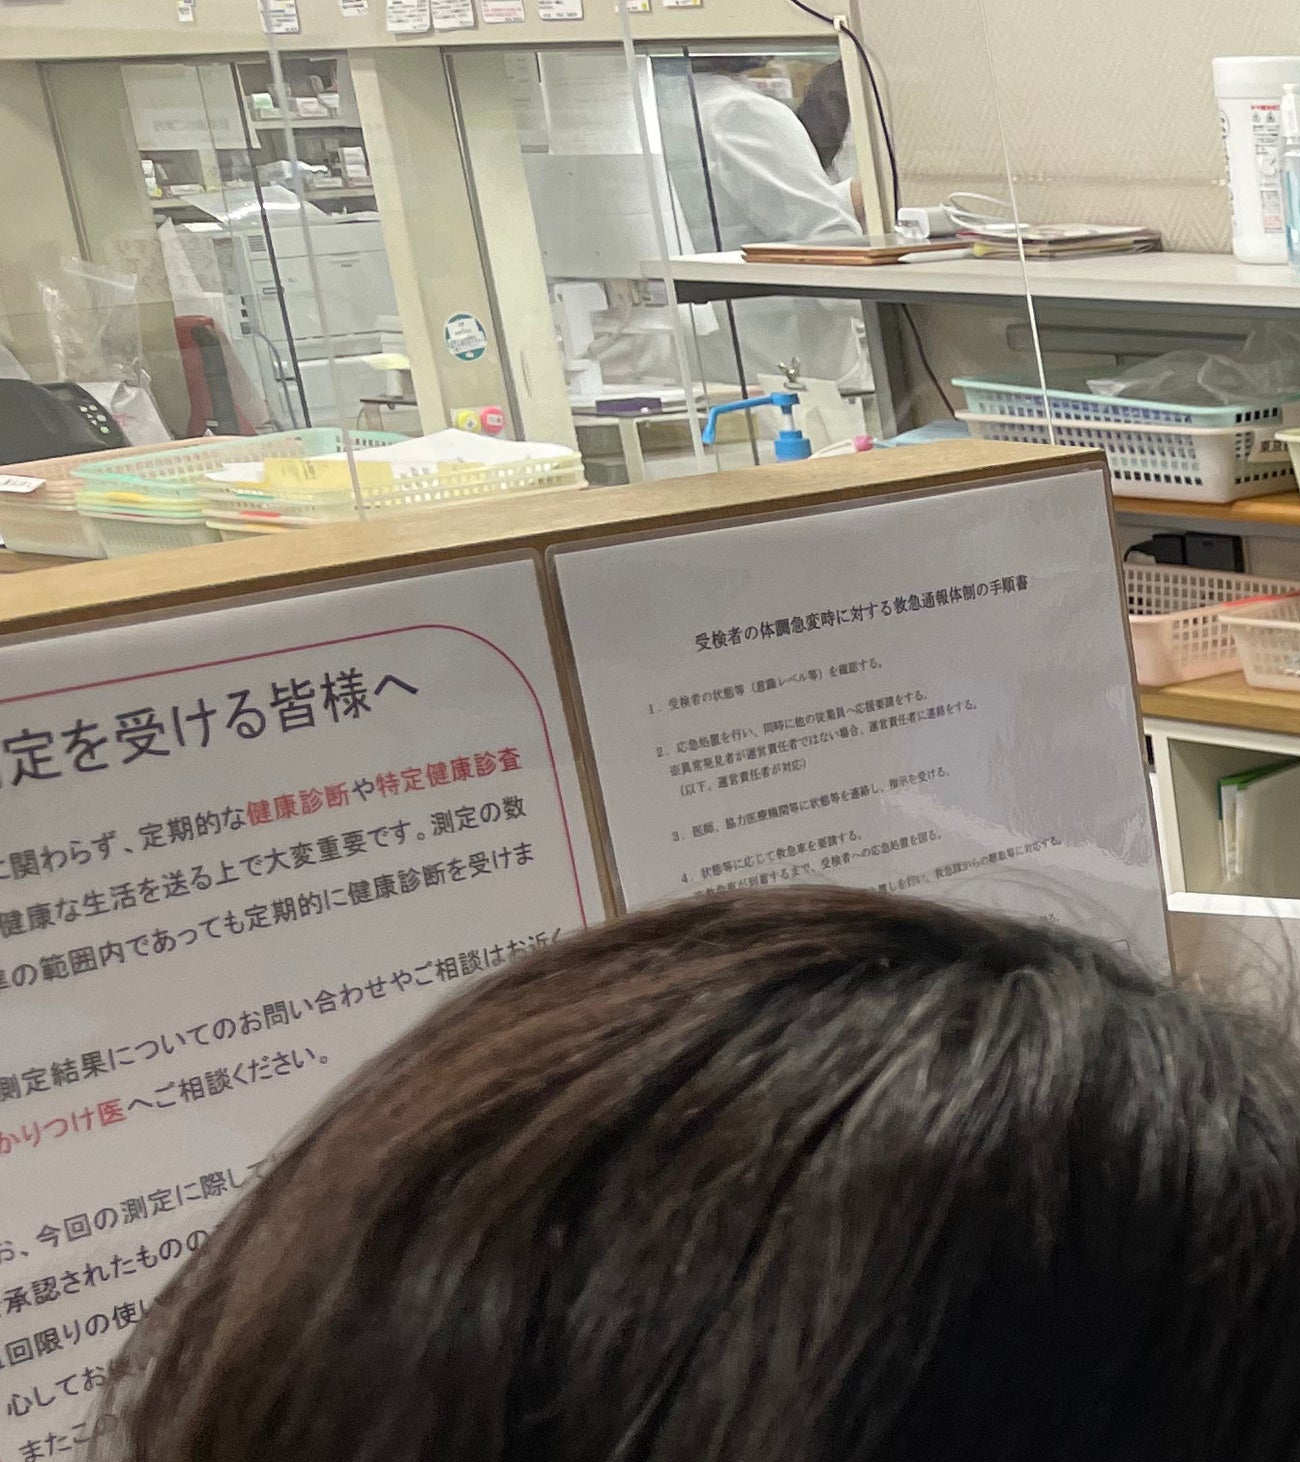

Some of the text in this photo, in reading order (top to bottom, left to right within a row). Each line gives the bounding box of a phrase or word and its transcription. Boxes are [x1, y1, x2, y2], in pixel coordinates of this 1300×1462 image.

[695, 574, 1028, 652] 受検者の体調急変時に対する救急通報体制の手順書
[0, 668, 419, 791] 定を受ける皆様へ
[0, 1299, 150, 1369] 回限りの使
